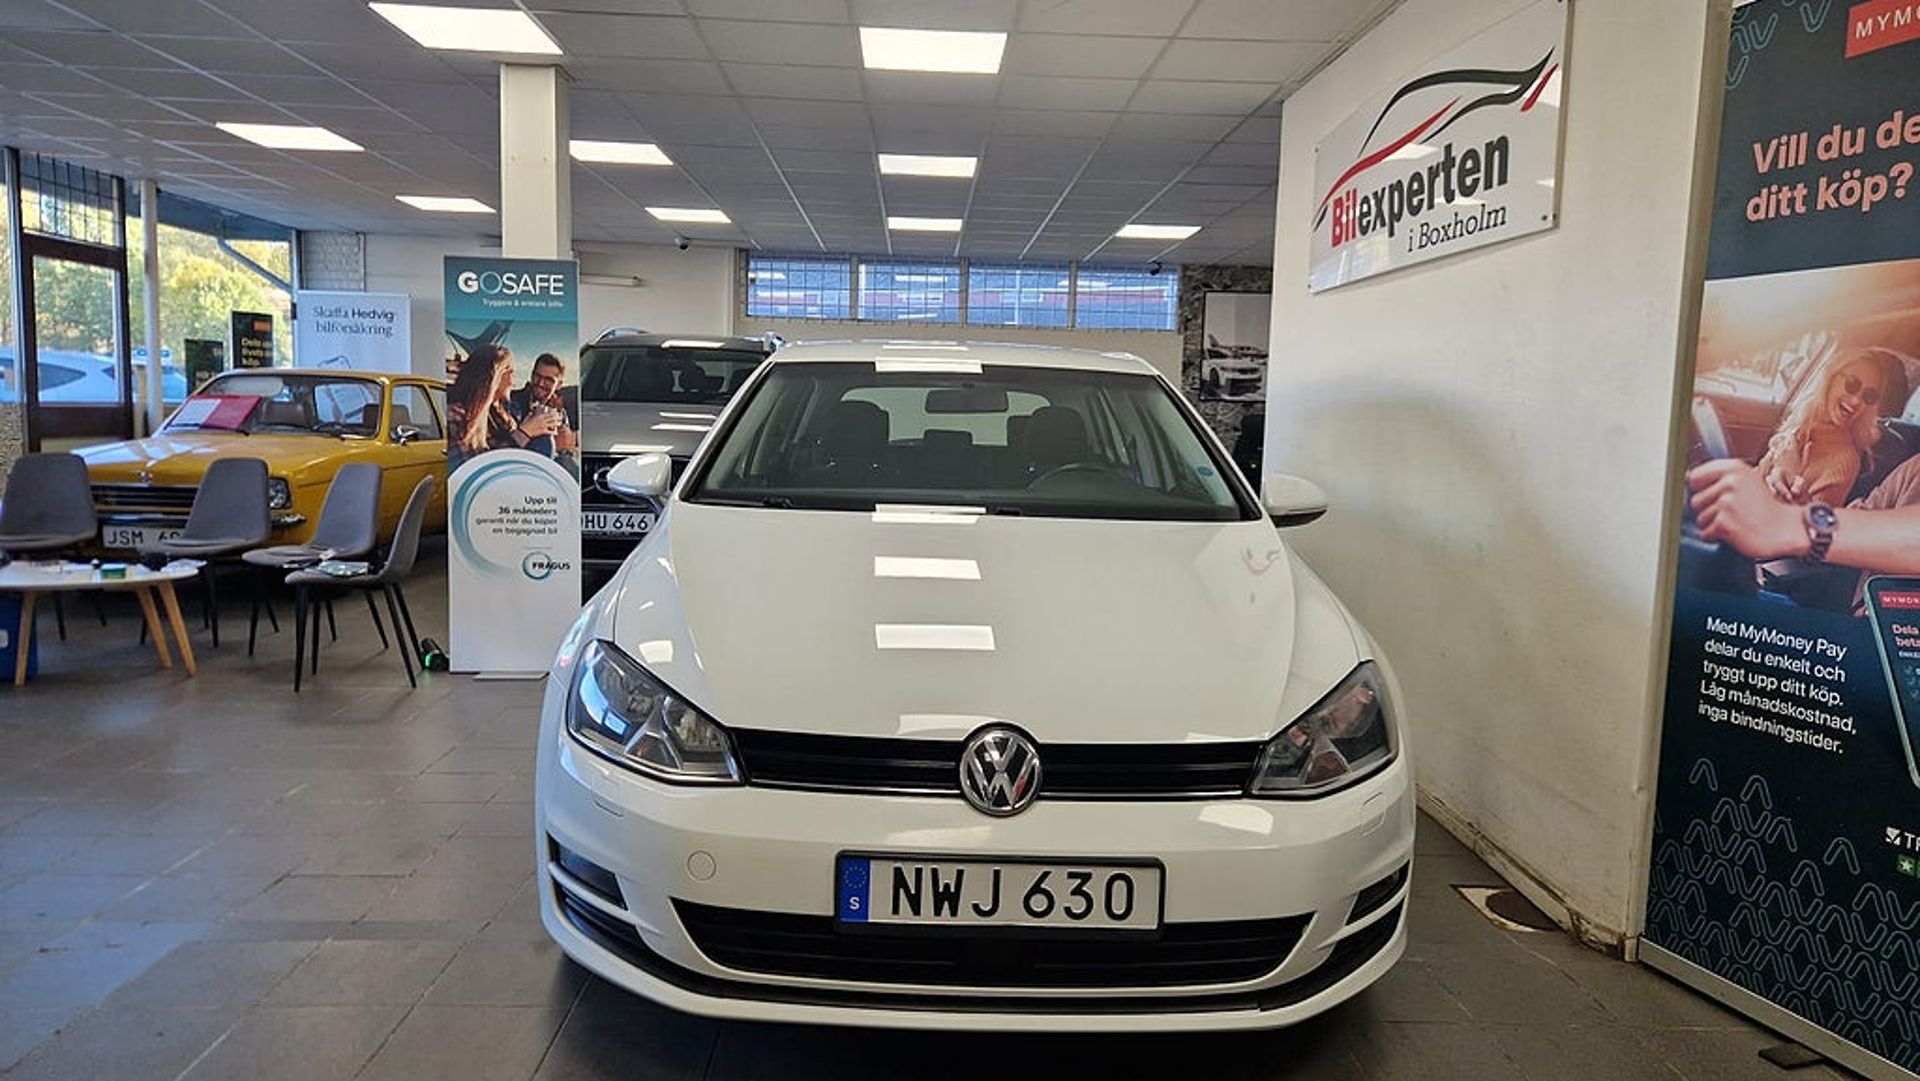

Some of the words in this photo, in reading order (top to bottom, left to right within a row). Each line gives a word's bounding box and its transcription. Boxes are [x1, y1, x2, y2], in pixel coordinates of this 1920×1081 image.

[1753, 131, 1808, 174] Vill
[1816, 123, 1866, 161] du
[1331, 134, 1509, 248] Bilexperten
[1746, 181, 1808, 222] ditt
[1816, 161, 1914, 213] köp?
[1407, 229, 1414, 253] i
[1418, 203, 1507, 251] Boxholm
[458, 271, 564, 295] GOSAFE
[313, 306, 348, 318] Skaffa
[352, 308, 394, 323] Hedvig
[316, 320, 392, 338] bilförsäkring
[512, 506, 557, 515] månaders
[524, 496, 544, 505] Upp
[546, 496, 557, 504] till
[613, 514, 648, 531] 646
[108, 530, 144, 545] JSM
[1706, 616, 1737, 635] Med
[1739, 623, 1813, 654] MyMoney
[1816, 638, 1847, 662] Pay
[1891, 623, 1919, 635] Dela
[1703, 659, 1745, 683] tryggt
[1749, 672, 1777, 691] upp
[1780, 678, 1806, 697] ditt
[1809, 683, 1844, 707] köp.
[1704, 638, 1739, 658] delar
[1742, 648, 1761, 663] du
[1764, 652, 1811, 675] enkelt
[1814, 664, 1846, 683] och
[1698, 700, 1728, 722] inga
[1730, 708, 1843, 754] bindningstider.
[1700, 679, 1726, 702] Låg
[1728, 690, 1857, 735] månadskostnad,
[849, 896, 860, 910] S
[891, 865, 1002, 918] NWJ
[1023, 870, 1134, 921] 630
